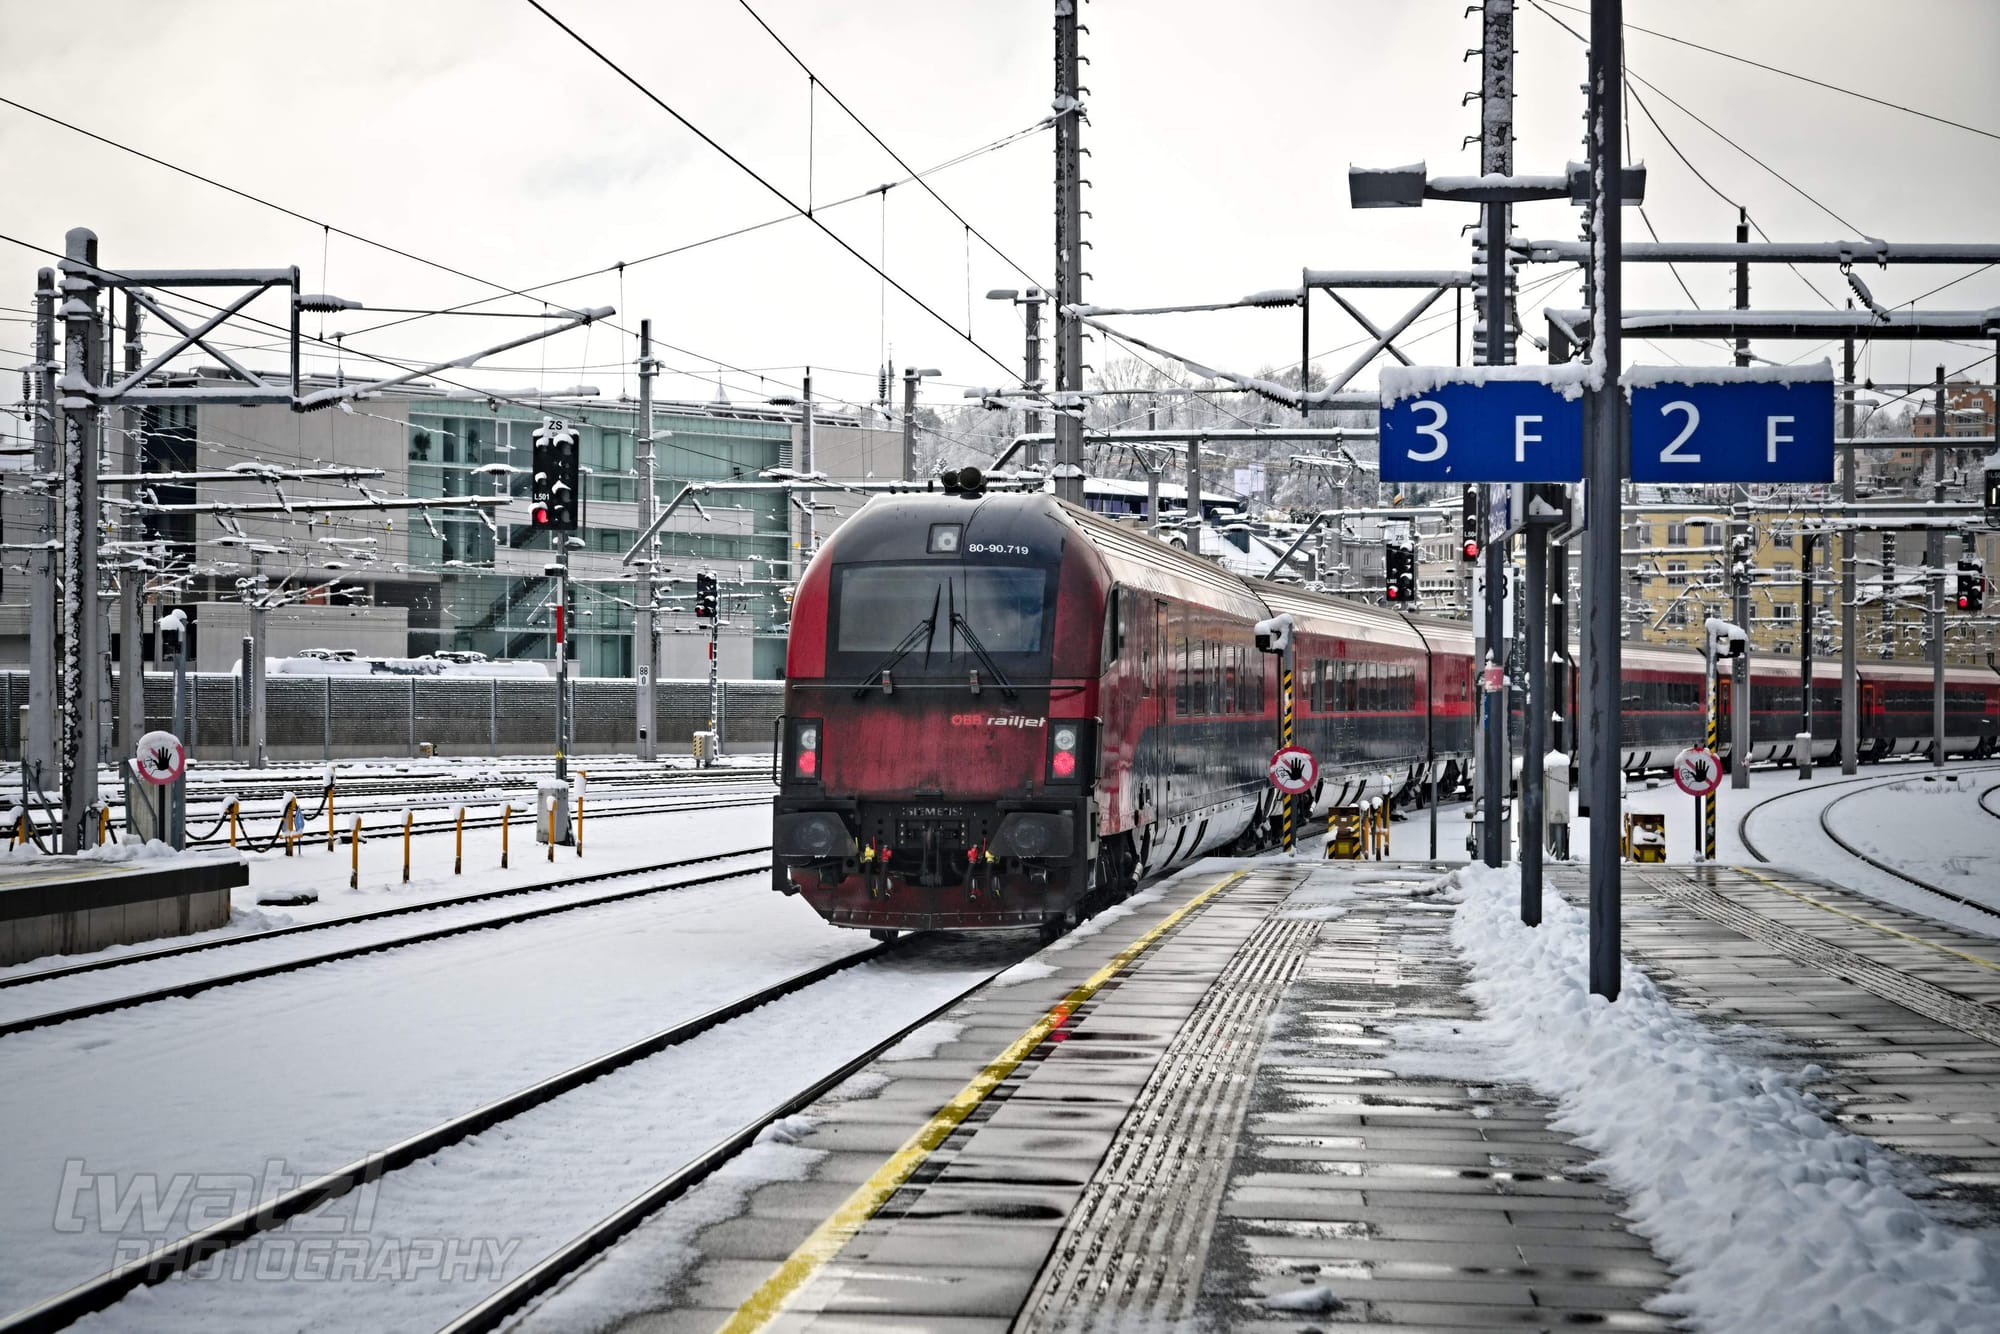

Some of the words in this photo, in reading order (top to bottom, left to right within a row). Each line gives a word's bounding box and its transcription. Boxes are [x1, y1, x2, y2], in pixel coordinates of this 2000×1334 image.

[549, 420, 563, 430] ZS
[1407, 401, 1449, 462] 3
[1515, 415, 1543, 462] F
[1659, 401, 1701, 463] 2
[1767, 415, 1795, 463] F
[968, 543, 1029, 555] 80-90.719
[986, 715, 1046, 729] railjet
